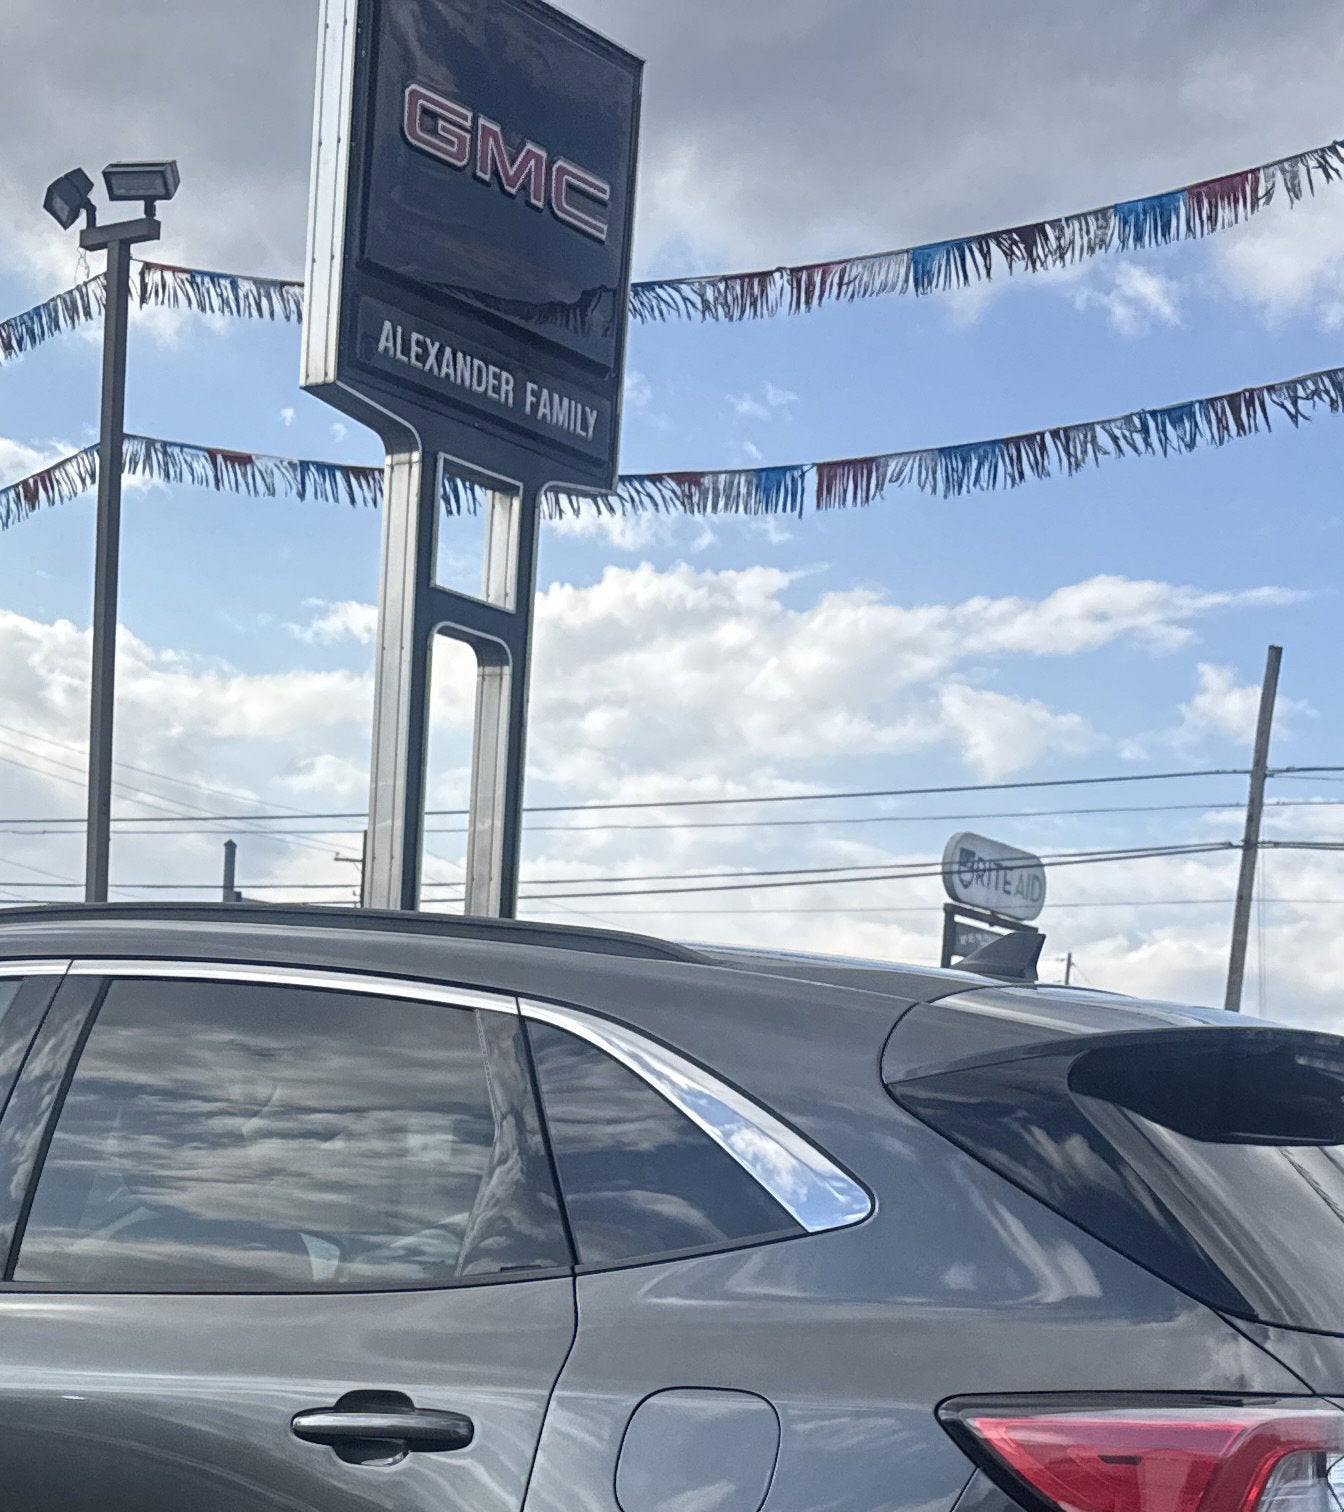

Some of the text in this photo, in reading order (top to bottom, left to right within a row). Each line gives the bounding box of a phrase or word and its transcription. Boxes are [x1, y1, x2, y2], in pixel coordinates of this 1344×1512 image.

[404, 83, 610, 241] GMC
[377, 319, 598, 441] ALEXANDER FAMILY
[976, 856, 1042, 903] RITE AID
